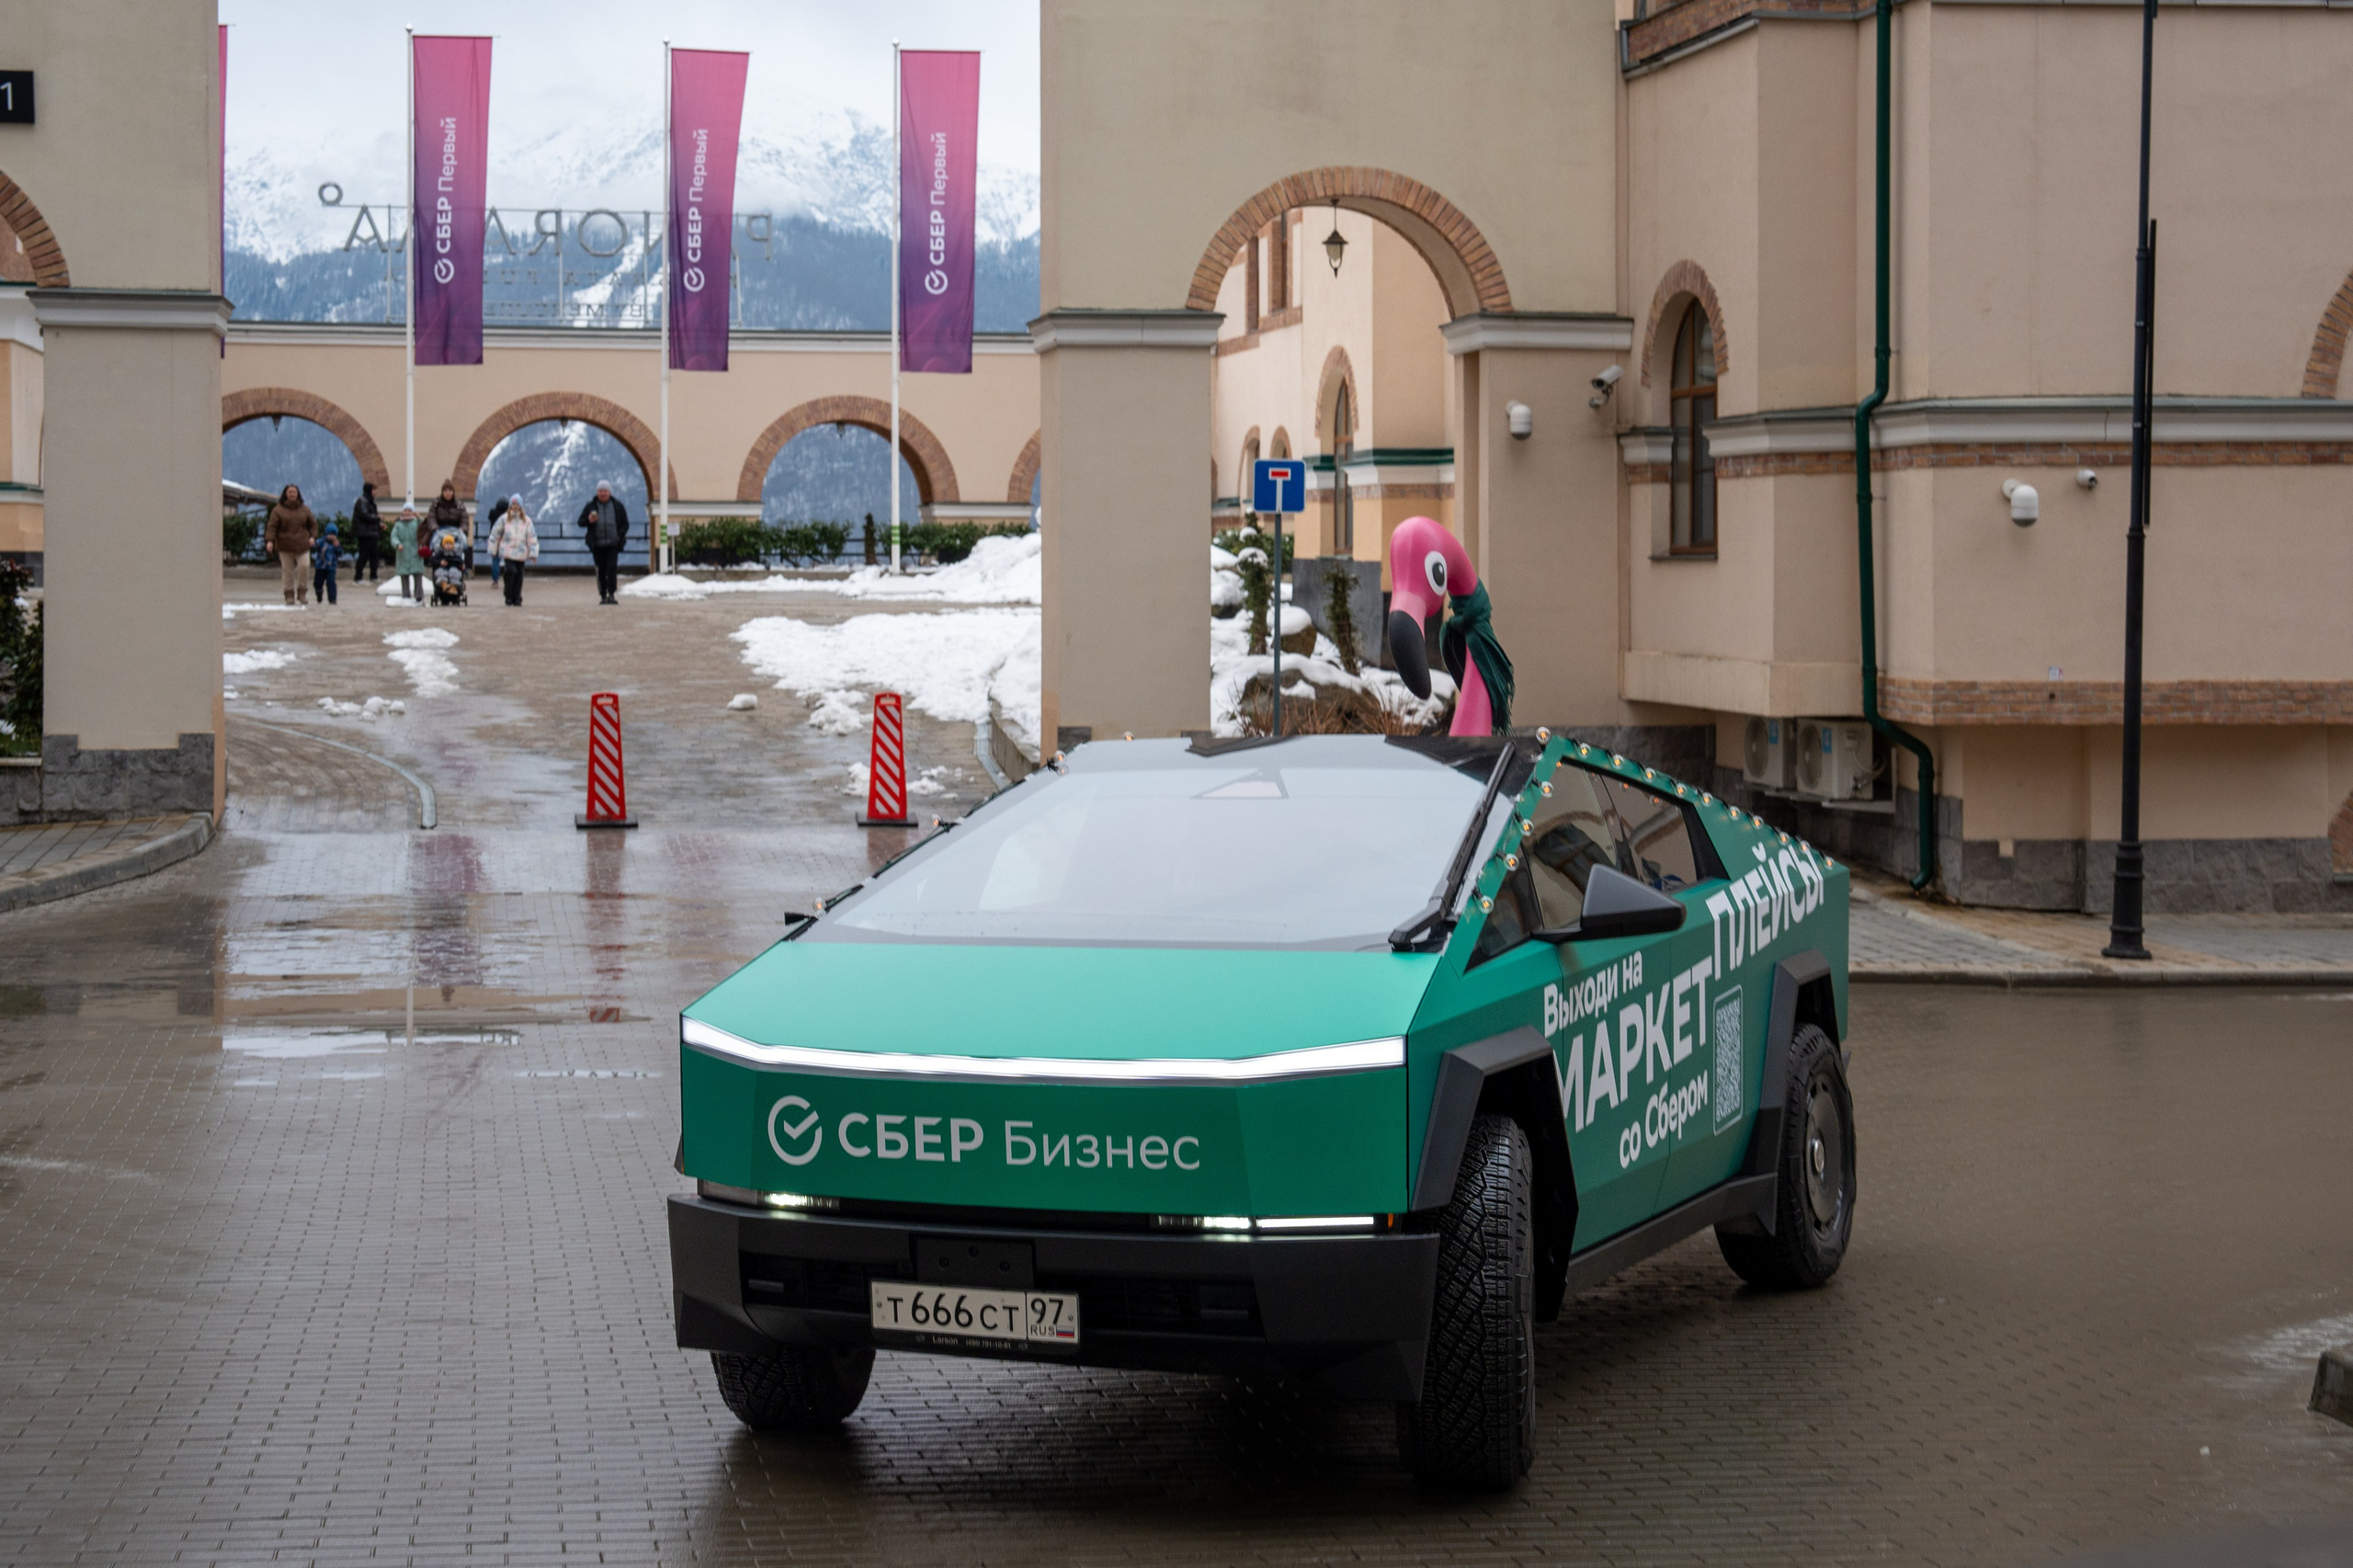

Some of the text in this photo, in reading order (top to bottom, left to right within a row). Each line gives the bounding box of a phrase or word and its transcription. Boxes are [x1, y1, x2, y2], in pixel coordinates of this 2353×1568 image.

[437, 117, 458, 254] СБЕР Первый
[688, 129, 708, 263] СБЕР Первый
[929, 132, 949, 266] СБЕР Первый
[1705, 842, 1824, 981] ПЛЕЙСЫ
[1543, 951, 1643, 1038] Выходи на
[1552, 955, 1712, 1133] МАРКЕТ
[838, 1112, 1200, 1170] СБЕР Бизнес
[1619, 1070, 1709, 1169] со Сбером
[932, 1335, 958, 1346] Larson
[1030, 1298, 1063, 1324] 97
[1030, 1325, 1054, 1336] RUS
